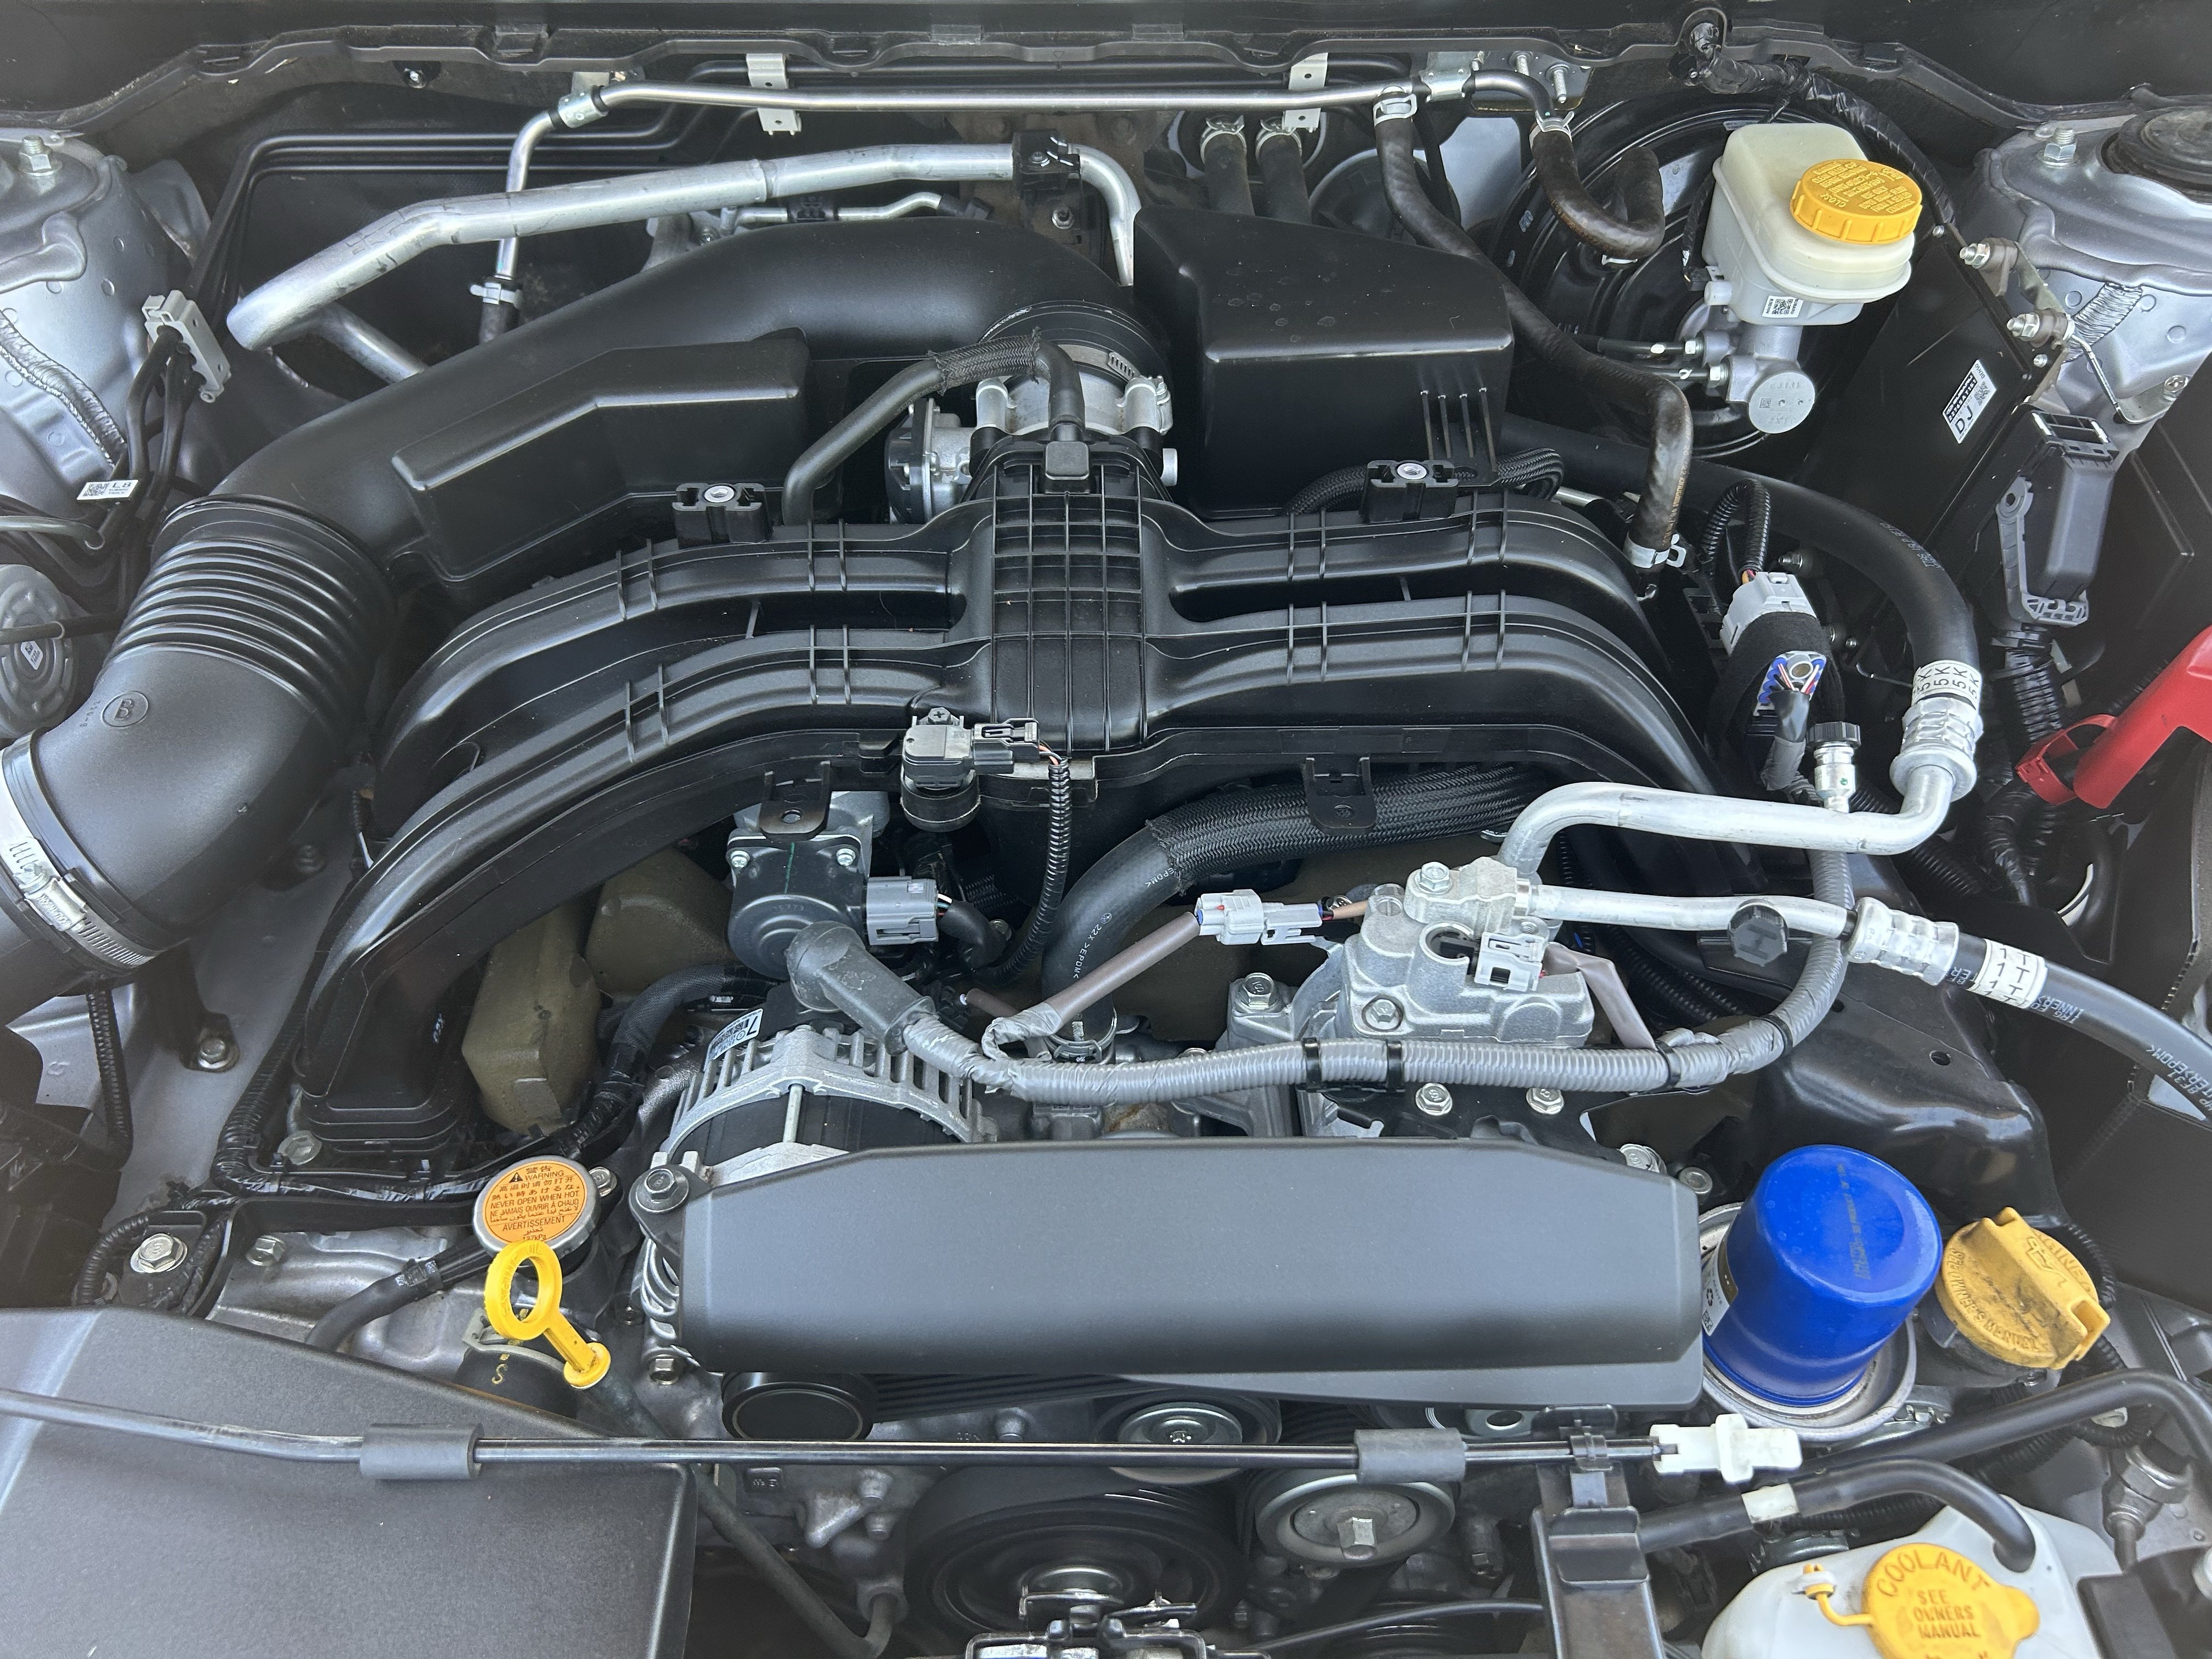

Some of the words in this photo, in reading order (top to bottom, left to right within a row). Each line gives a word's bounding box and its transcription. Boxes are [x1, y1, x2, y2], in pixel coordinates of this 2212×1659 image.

[114, 698, 134, 720] B
[524, 1170, 565, 1181] WARNING
[526, 1165, 552, 1175] 警告
[499, 1176, 574, 1192] 高温时请勿打开
[490, 1199, 515, 1209] NEVER
[517, 1197, 537, 1205] OPEN
[539, 1194, 562, 1202] WHEN
[500, 1206, 523, 1216] JAMAIS
[526, 1203, 549, 1212] OUVRIR
[550, 1200, 556, 1208] À
[502, 1215, 565, 1232] AVERTISSEMENT
[528, 1244, 543, 1255] OIL
[1876, 1549, 1991, 1598] COOLANT
[1917, 1588, 1949, 1605] SEE
[1912, 1605, 1975, 1622] OWNERS
[1917, 1623, 1982, 1639] MANUAL
